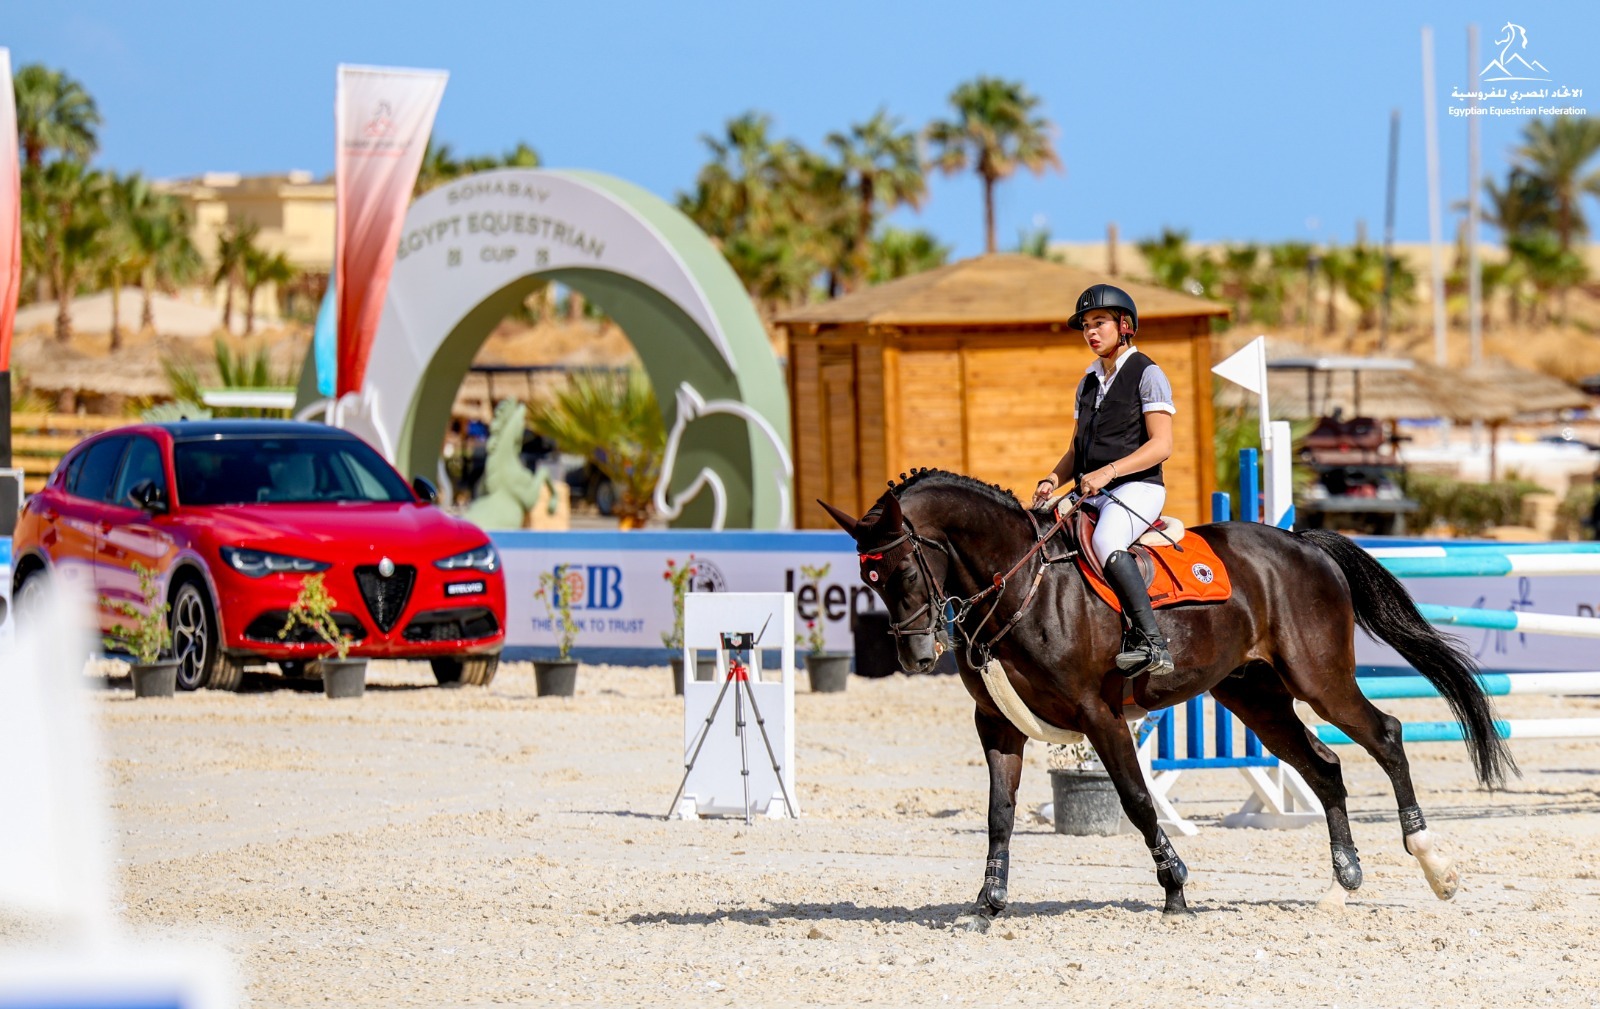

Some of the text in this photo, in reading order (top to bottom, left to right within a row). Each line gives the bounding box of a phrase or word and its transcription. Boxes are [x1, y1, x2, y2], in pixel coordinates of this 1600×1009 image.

[467, 211, 606, 259] EQUESTRIAN
[479, 246, 518, 263] CUP
[532, 618, 552, 632] THE
[590, 618, 606, 632] TO
[608, 618, 644, 633] TRUST
